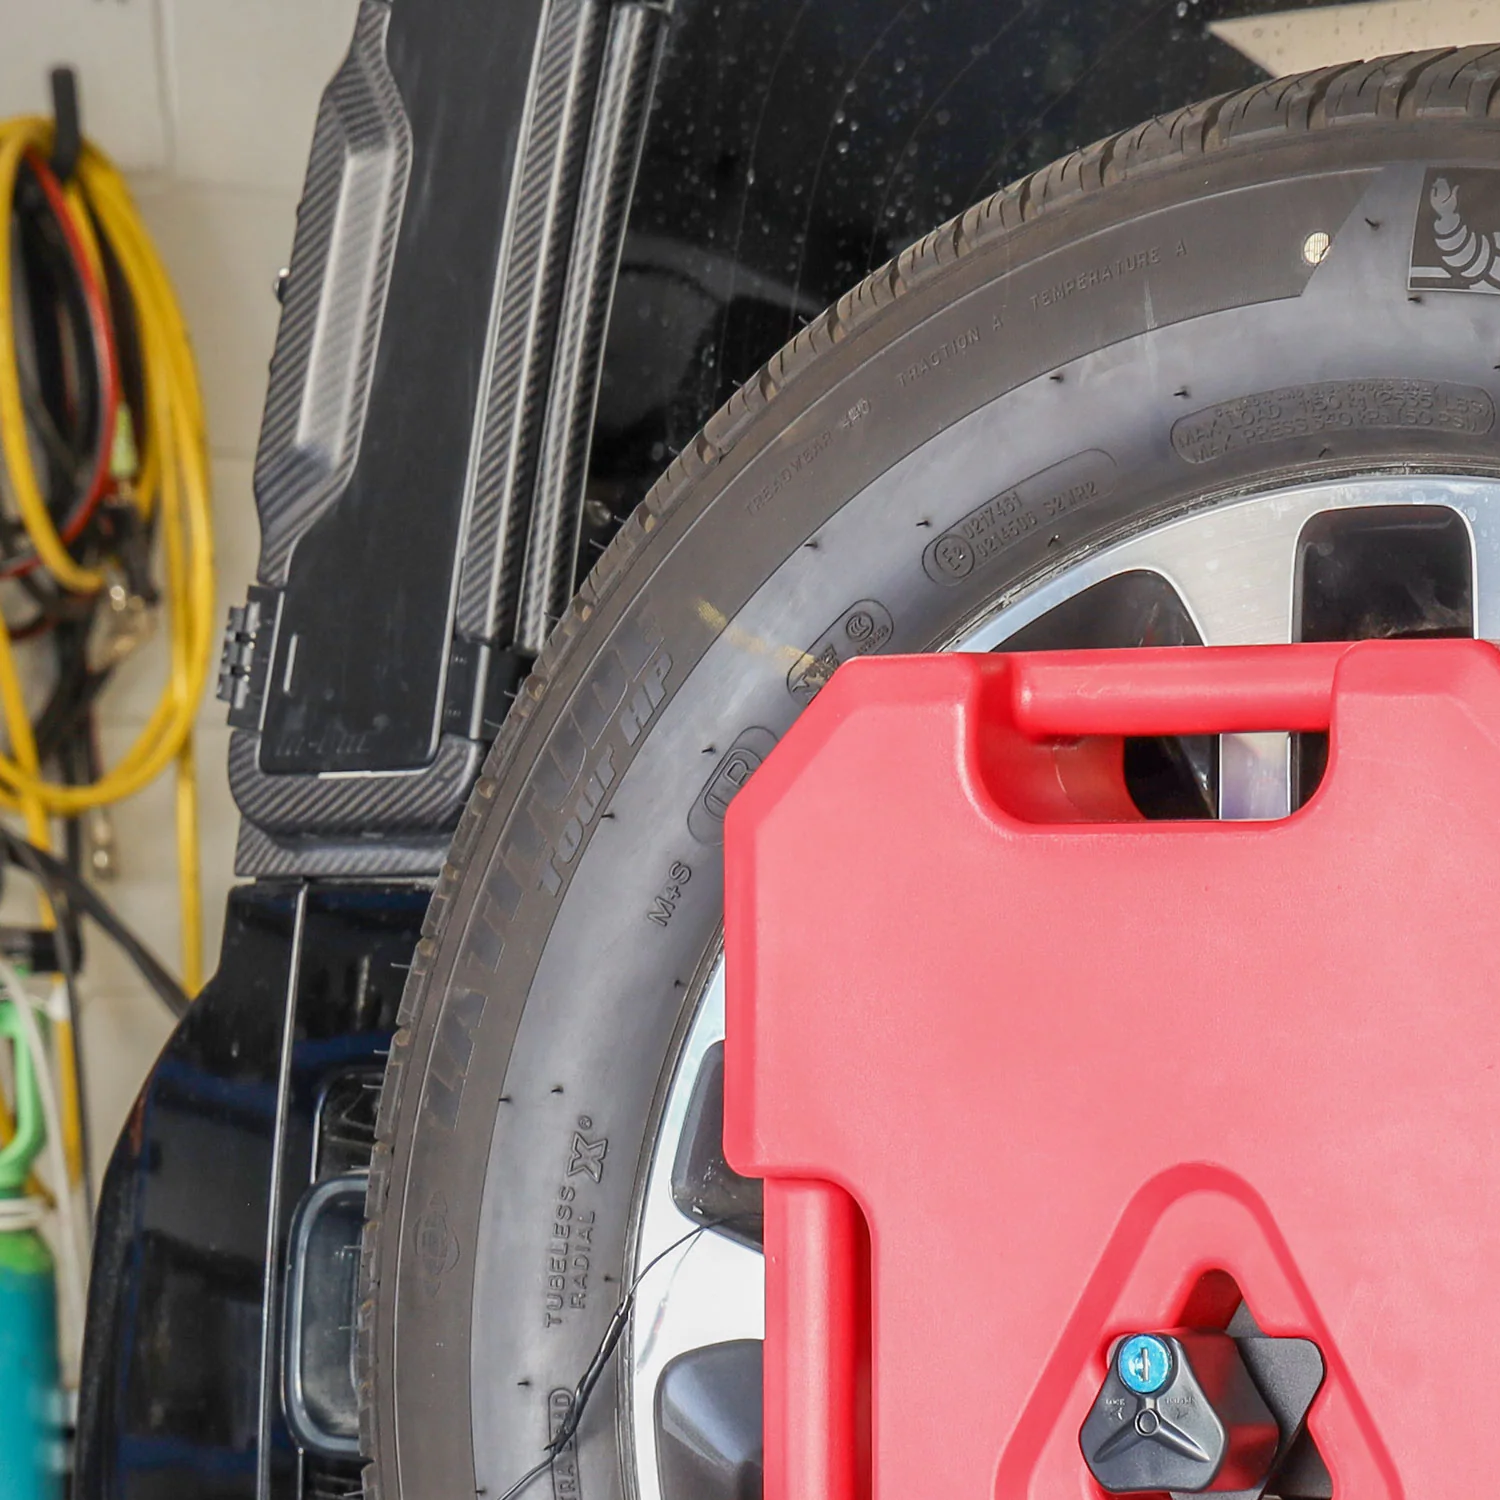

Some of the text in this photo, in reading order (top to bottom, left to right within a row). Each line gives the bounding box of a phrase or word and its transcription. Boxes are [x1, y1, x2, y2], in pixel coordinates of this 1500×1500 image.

[896, 326, 983, 389] TRACTION
[1029, 248, 1162, 312] TEMPERATURE
[1227, 402, 1283, 430] LOAD
[537, 655, 674, 898] Tour HP
[647, 861, 692, 927] M+S
[546, 1185, 573, 1328] TUBELESS
[569, 1212, 595, 1309] RADIAL
